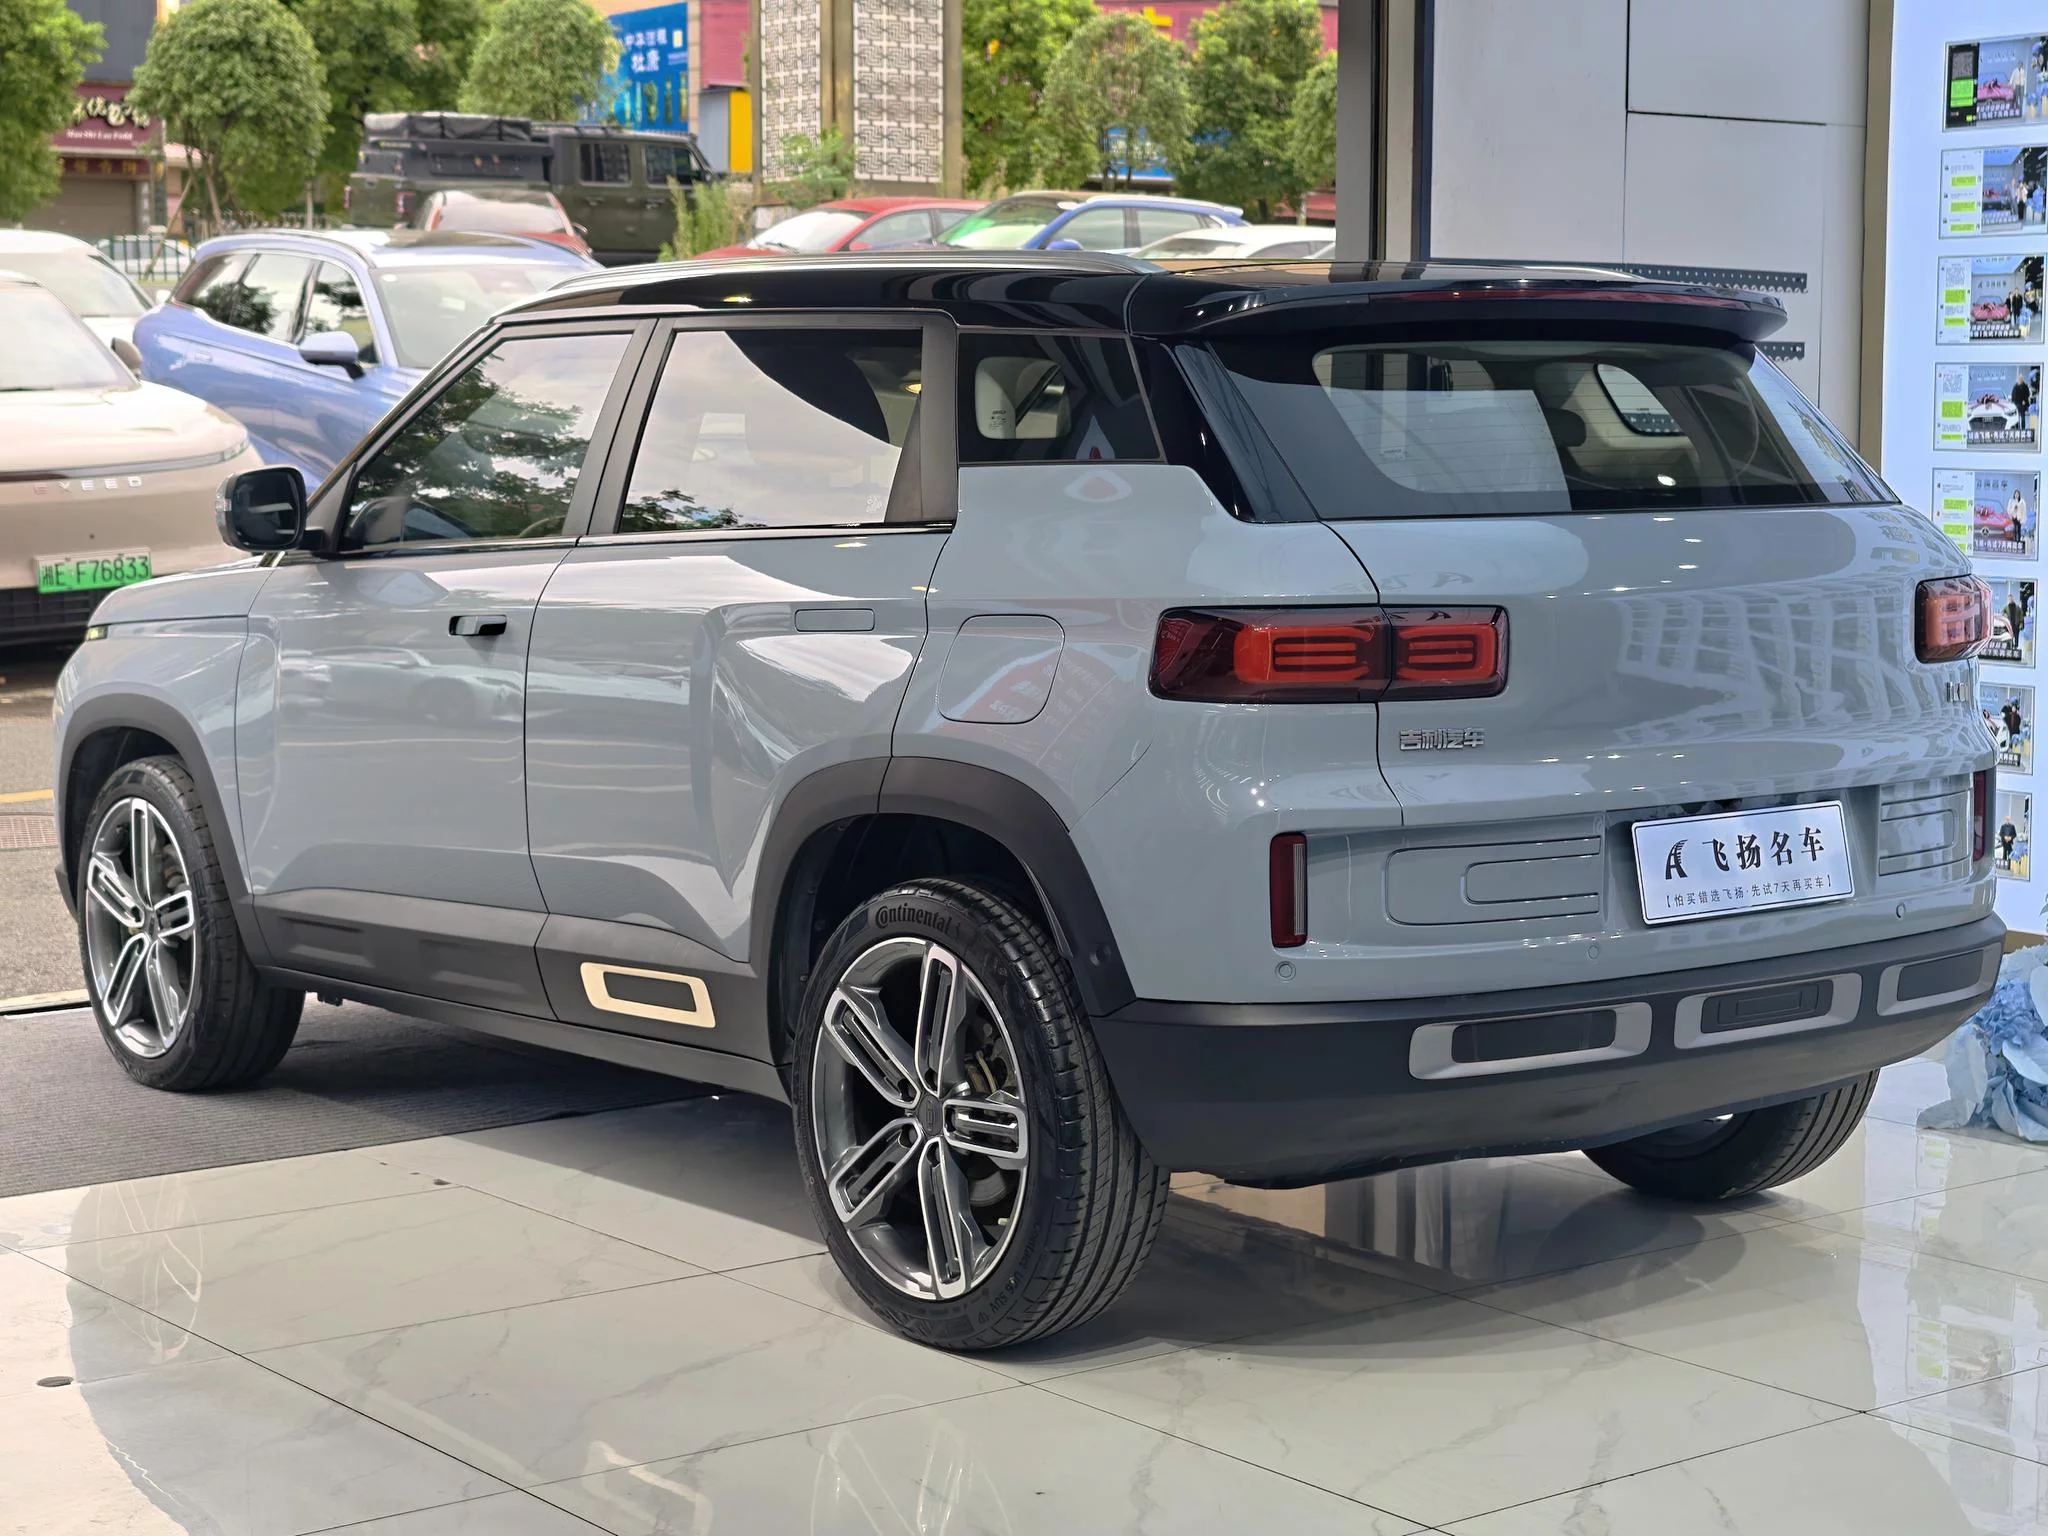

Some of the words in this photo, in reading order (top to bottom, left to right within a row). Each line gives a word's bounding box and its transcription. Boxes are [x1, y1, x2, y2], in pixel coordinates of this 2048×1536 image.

[33, 476, 142, 494] EXEED
[1400, 727, 1485, 751] 吉利汽车
[1702, 827, 1825, 872] 飞扬名车
[875, 903, 952, 937] Continental
